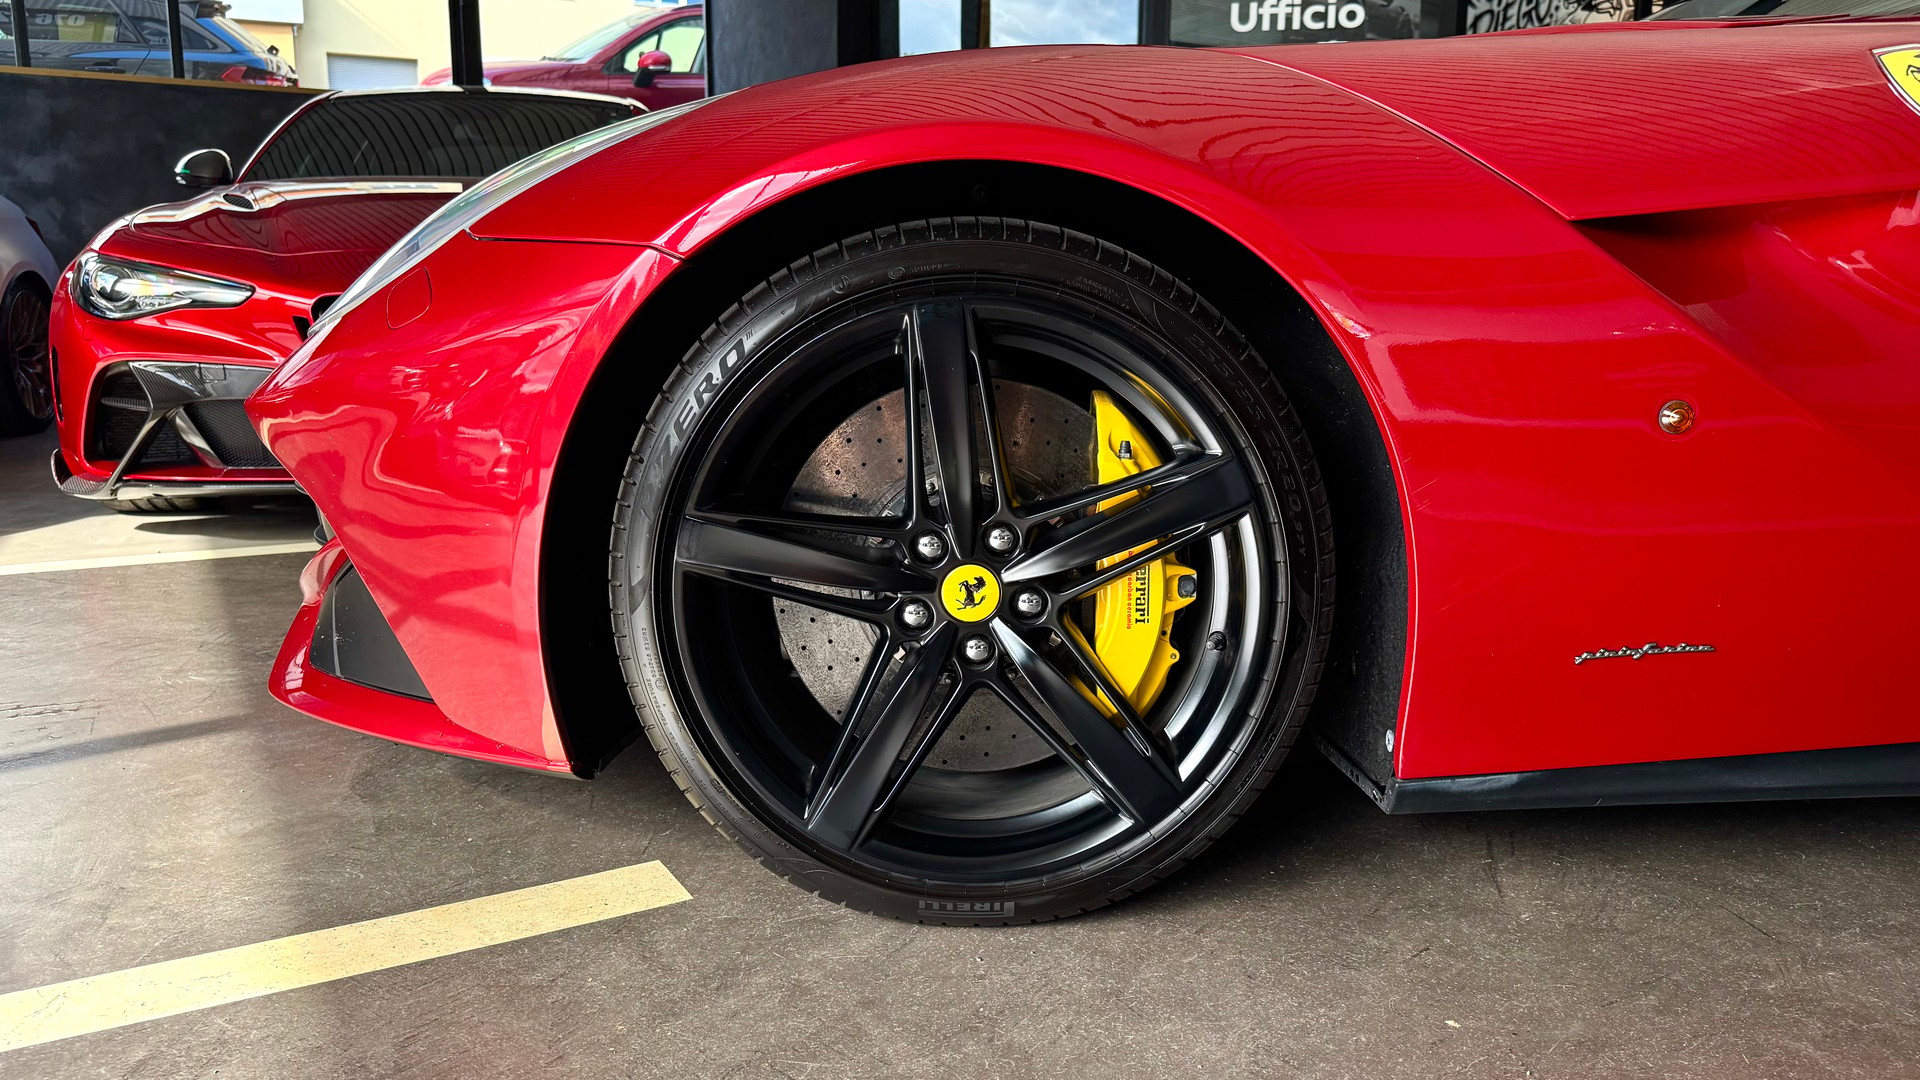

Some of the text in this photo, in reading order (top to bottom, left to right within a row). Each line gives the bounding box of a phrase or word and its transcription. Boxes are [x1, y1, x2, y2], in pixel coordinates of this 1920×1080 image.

[1231, 0, 1365, 32] Ufficio
[1135, 565, 1150, 624] errari
[1574, 642, 1715, 665] pininfarina
[918, 900, 1015, 918] PIRELLI
